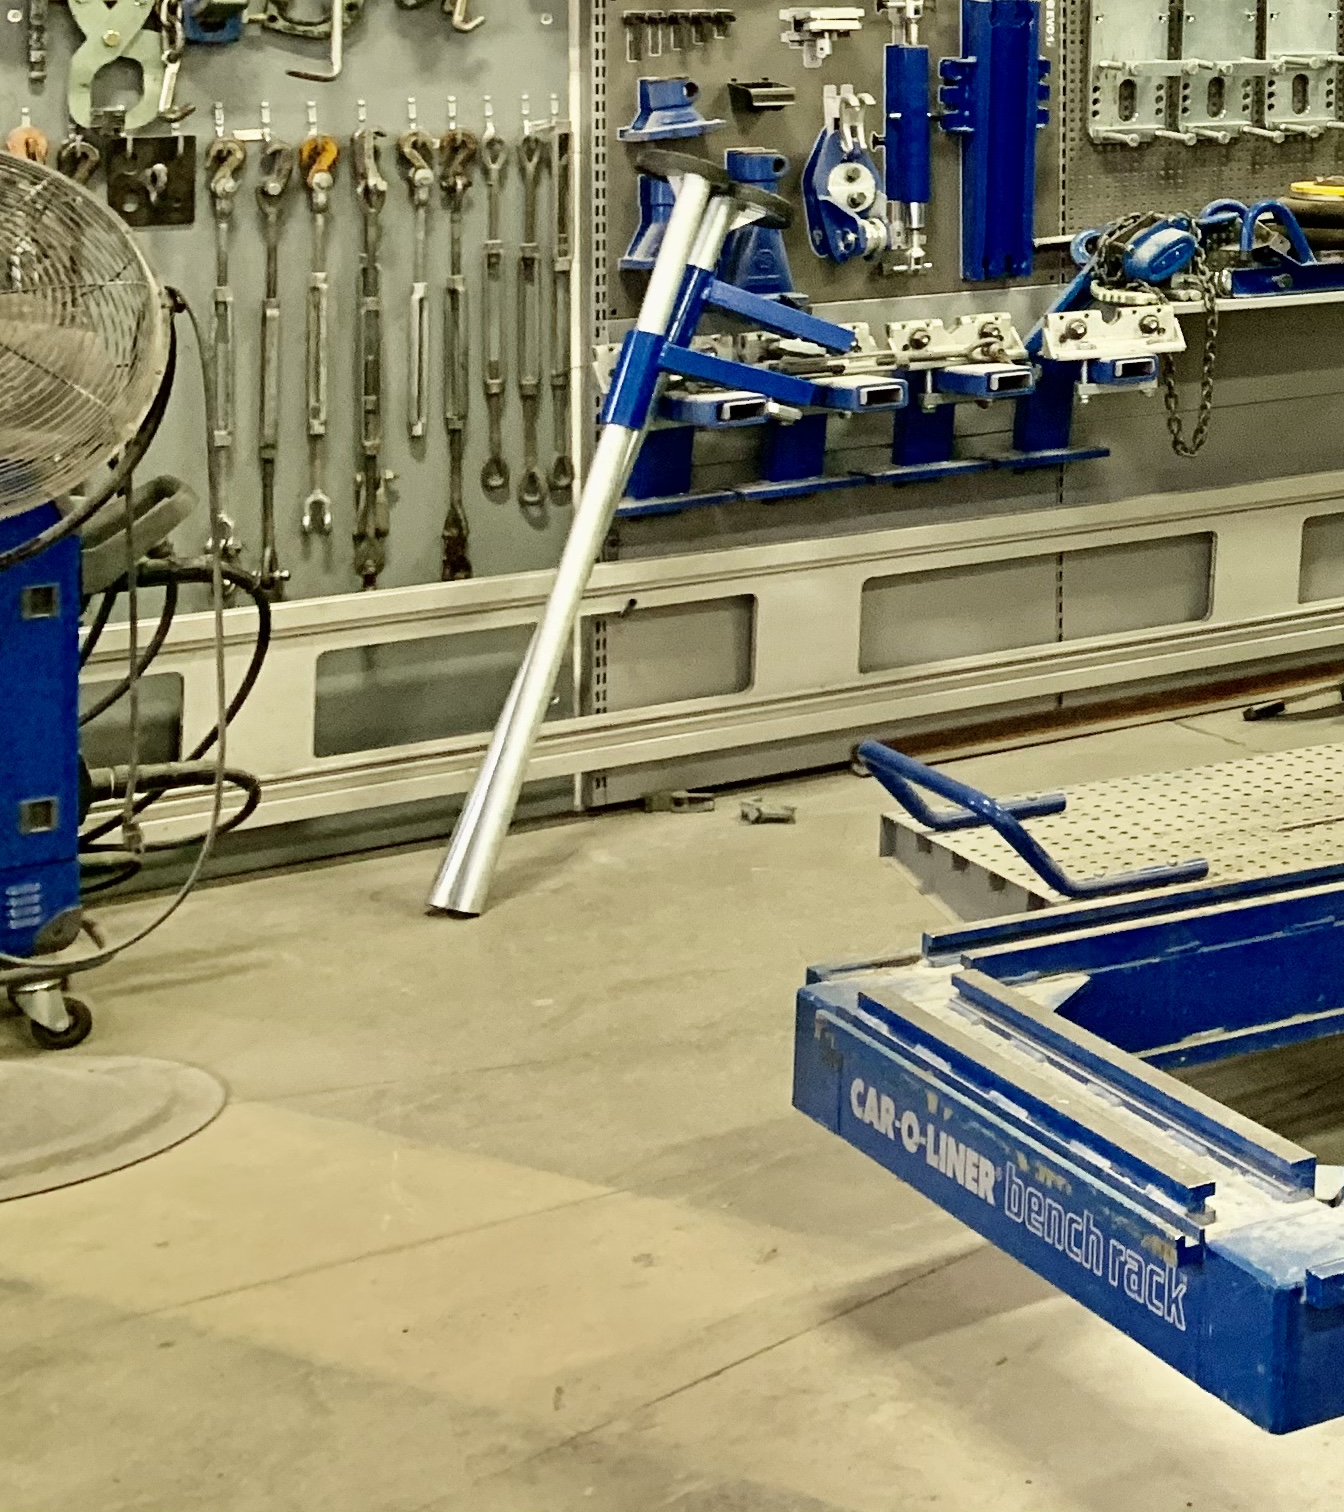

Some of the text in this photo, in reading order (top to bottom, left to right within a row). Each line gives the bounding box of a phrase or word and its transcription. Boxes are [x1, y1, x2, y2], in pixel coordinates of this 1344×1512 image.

[850, 1077, 1188, 1332] CAR-O-LINER bench rack
